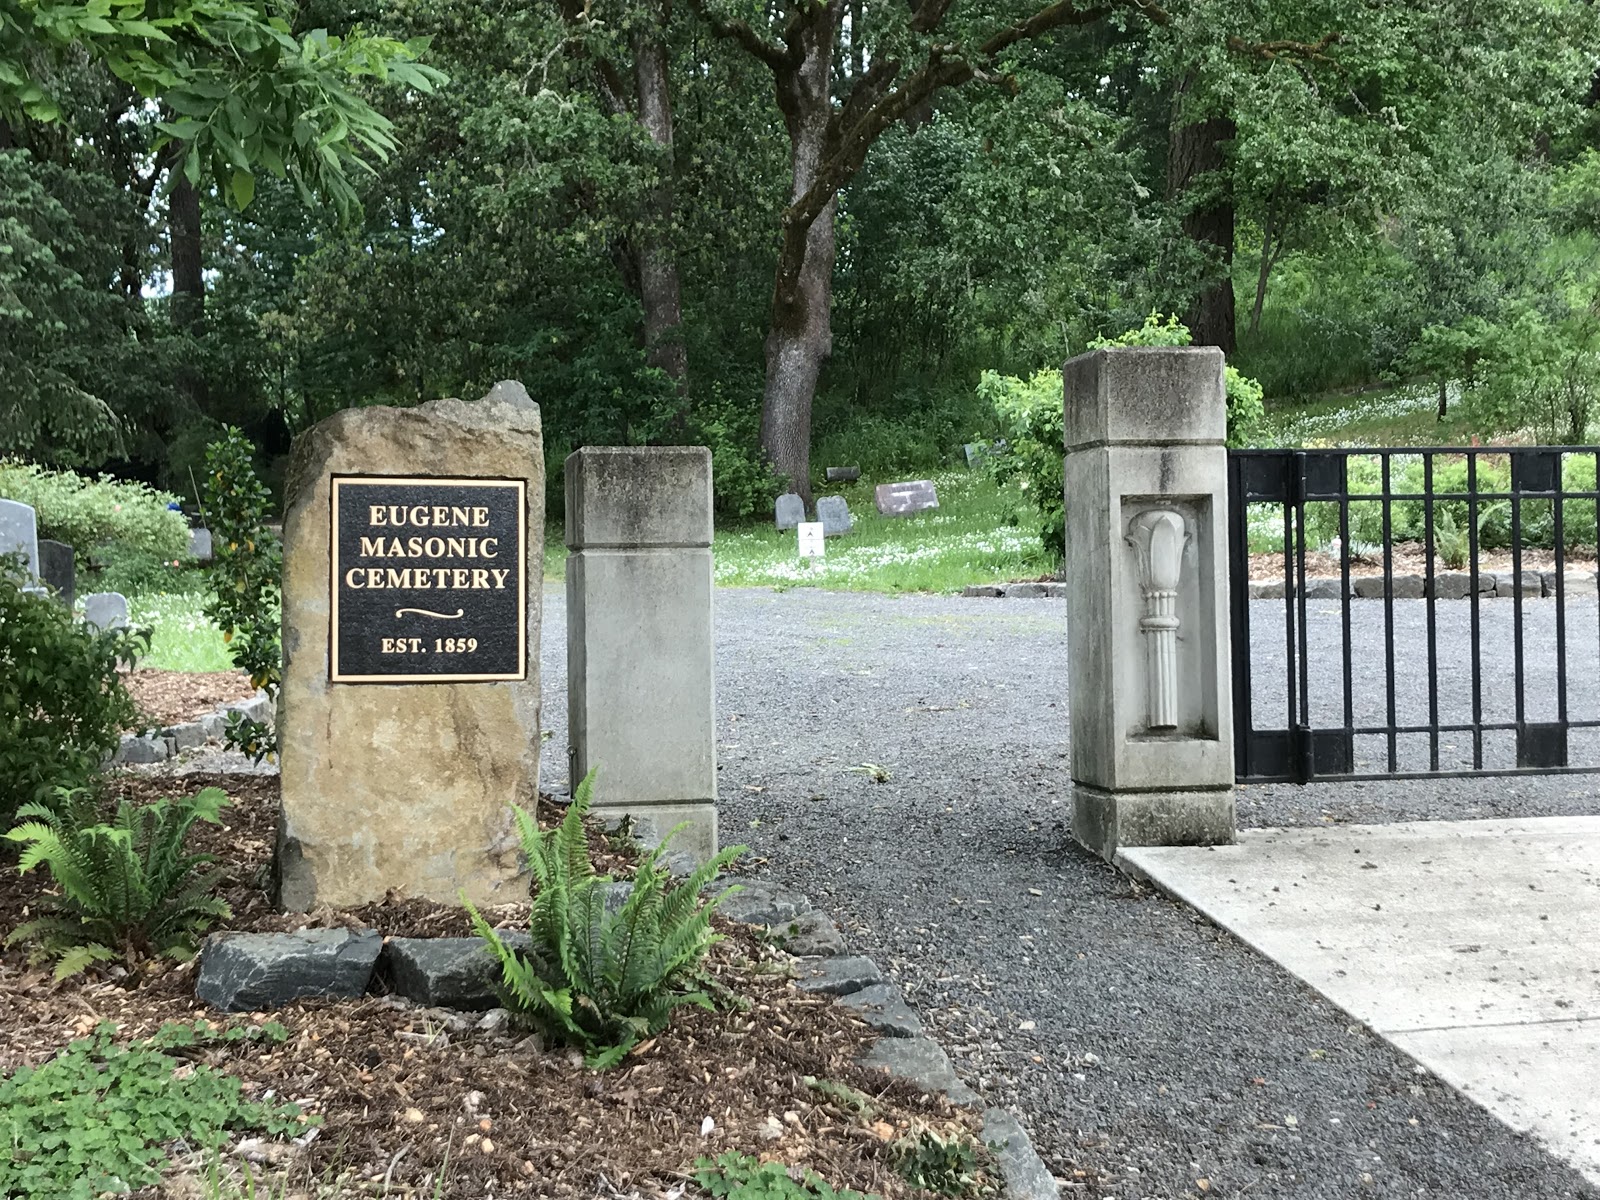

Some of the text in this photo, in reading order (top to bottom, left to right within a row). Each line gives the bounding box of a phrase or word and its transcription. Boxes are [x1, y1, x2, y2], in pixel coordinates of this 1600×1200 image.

[369, 505, 490, 527] EUGENE
[359, 536, 499, 558] MASONIC
[345, 568, 511, 589] CEMETERY
[381, 637, 478, 654] EST. 1859
